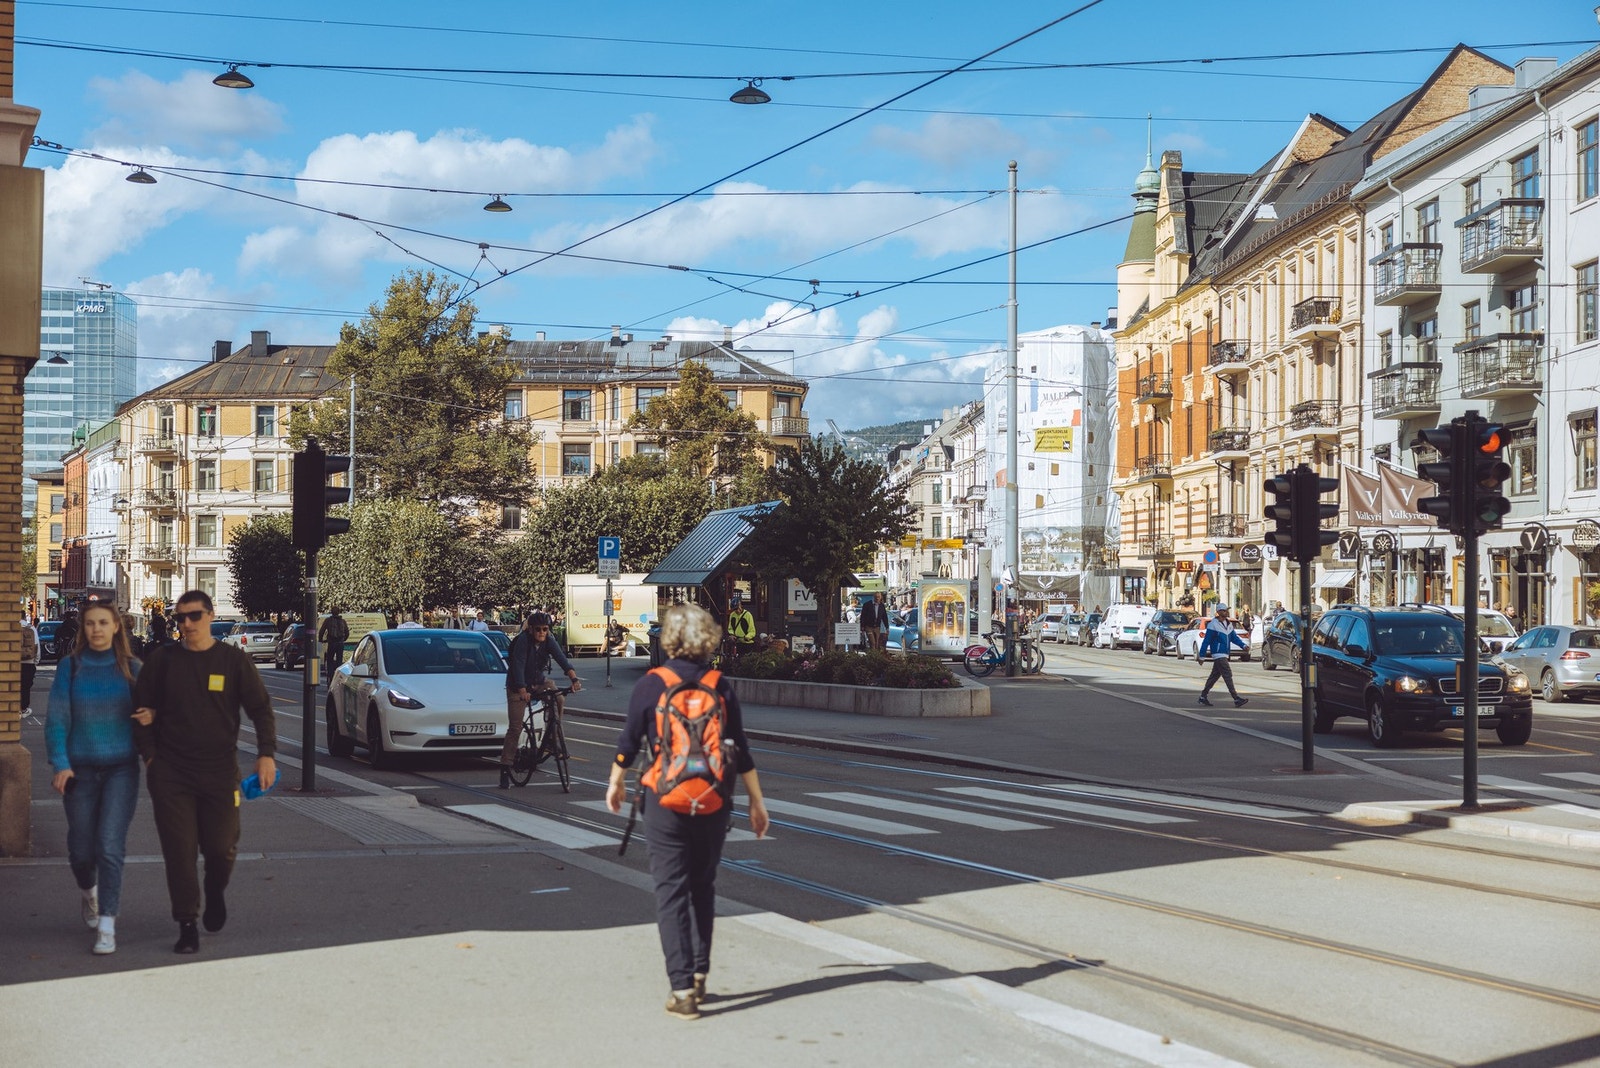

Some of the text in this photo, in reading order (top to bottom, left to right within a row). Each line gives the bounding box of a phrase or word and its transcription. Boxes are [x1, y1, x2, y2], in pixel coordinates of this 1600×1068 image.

[76, 305, 105, 313] KPMG
[1365, 487, 1379, 508] V
[1399, 484, 1415, 506] V
[1355, 510, 1381, 523] Valkyri
[1389, 509, 1430, 522] Valkyrien
[603, 540, 615, 556] P
[794, 590, 816, 601] FV
[1456, 707, 1464, 715] S
[456, 725, 494, 734] ED 77544
